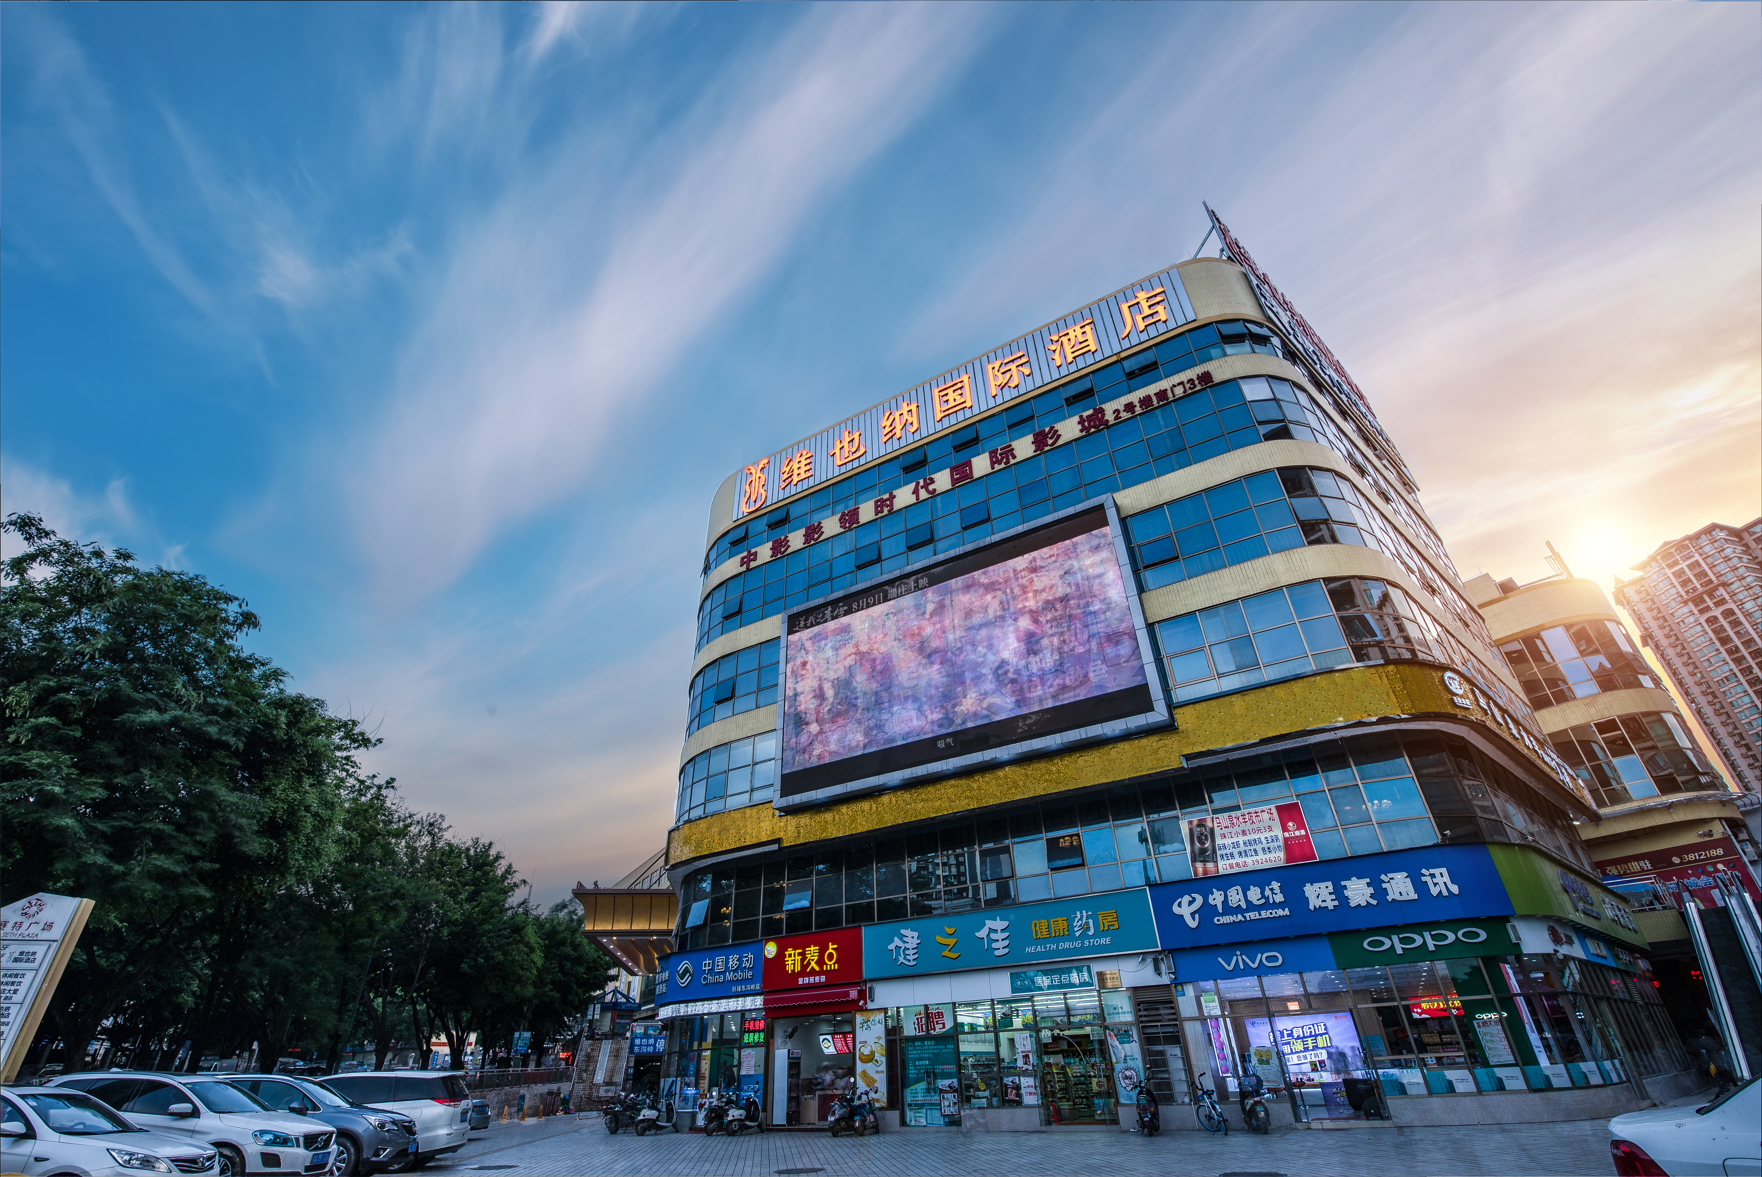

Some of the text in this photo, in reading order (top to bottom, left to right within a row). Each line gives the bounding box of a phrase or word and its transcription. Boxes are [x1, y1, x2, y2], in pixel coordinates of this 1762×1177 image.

[779, 286, 1169, 490] 维也纳国际酒店
[739, 406, 1109, 569] 中影影领时代国际影城
[1112, 370, 1214, 421] 2号楼南门3楼
[852, 592, 884, 612] 8月9日
[1251, 855, 1282, 866] 3924620
[1682, 848, 1724, 863] 3812188
[1208, 867, 1459, 914] 中国电信 辉豪通讯
[1213, 907, 1290, 926] CHINA TELECOM
[888, 909, 1120, 967] 健之佳 健康药房
[1025, 937, 1112, 954] HEALTH DRUG STORE
[702, 951, 754, 973] 中国移动
[784, 942, 838, 974] 新麦点
[1217, 950, 1283, 971] vivo
[701, 969, 753, 985] China Mobile
[1034, 972, 1090, 987] 医保定点药房
[634, 1037, 655, 1045] 维也纳
[634, 1045, 654, 1053] 东沟岭
[742, 1084, 759, 1092] X27
